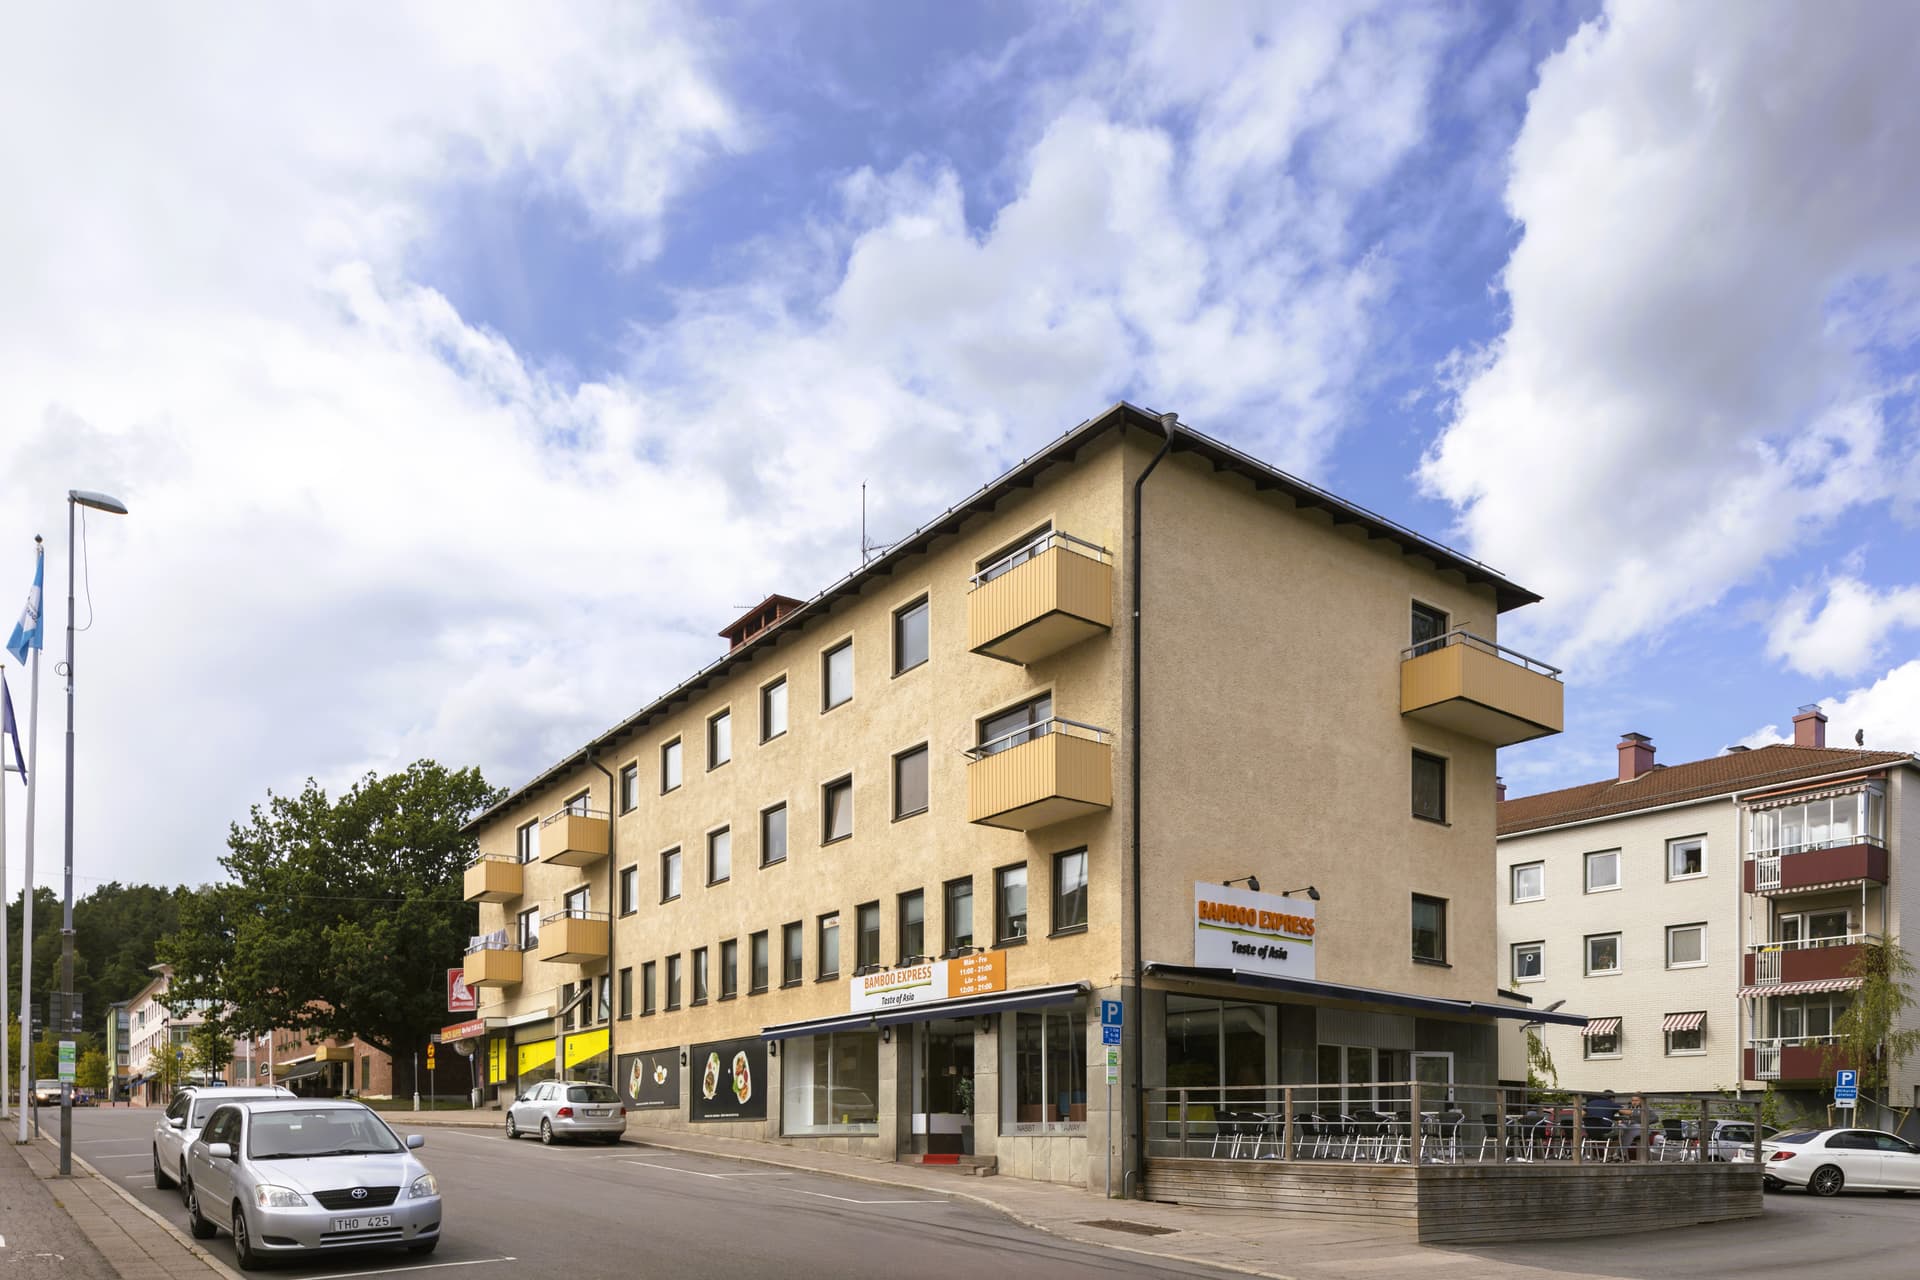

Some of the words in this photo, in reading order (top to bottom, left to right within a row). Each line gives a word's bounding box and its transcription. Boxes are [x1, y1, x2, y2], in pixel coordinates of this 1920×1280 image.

[1198, 900, 1257, 927] BAMBOO
[1259, 910, 1315, 936] EXPRESS
[1232, 940, 1257, 956] Taste
[1257, 945, 1268, 960] of
[1268, 945, 1288, 961] Asia
[864, 974, 895, 990] BAMBOO
[897, 966, 932, 984] EXPRESS
[881, 994, 896, 1006] Taste
[896, 993, 902, 1004] of
[902, 992, 915, 1003] Asia
[1107, 1002, 1119, 1023] P
[1842, 1072, 1853, 1085] P
[336, 1218, 359, 1230] THO
[367, 1216, 389, 1227] 425
